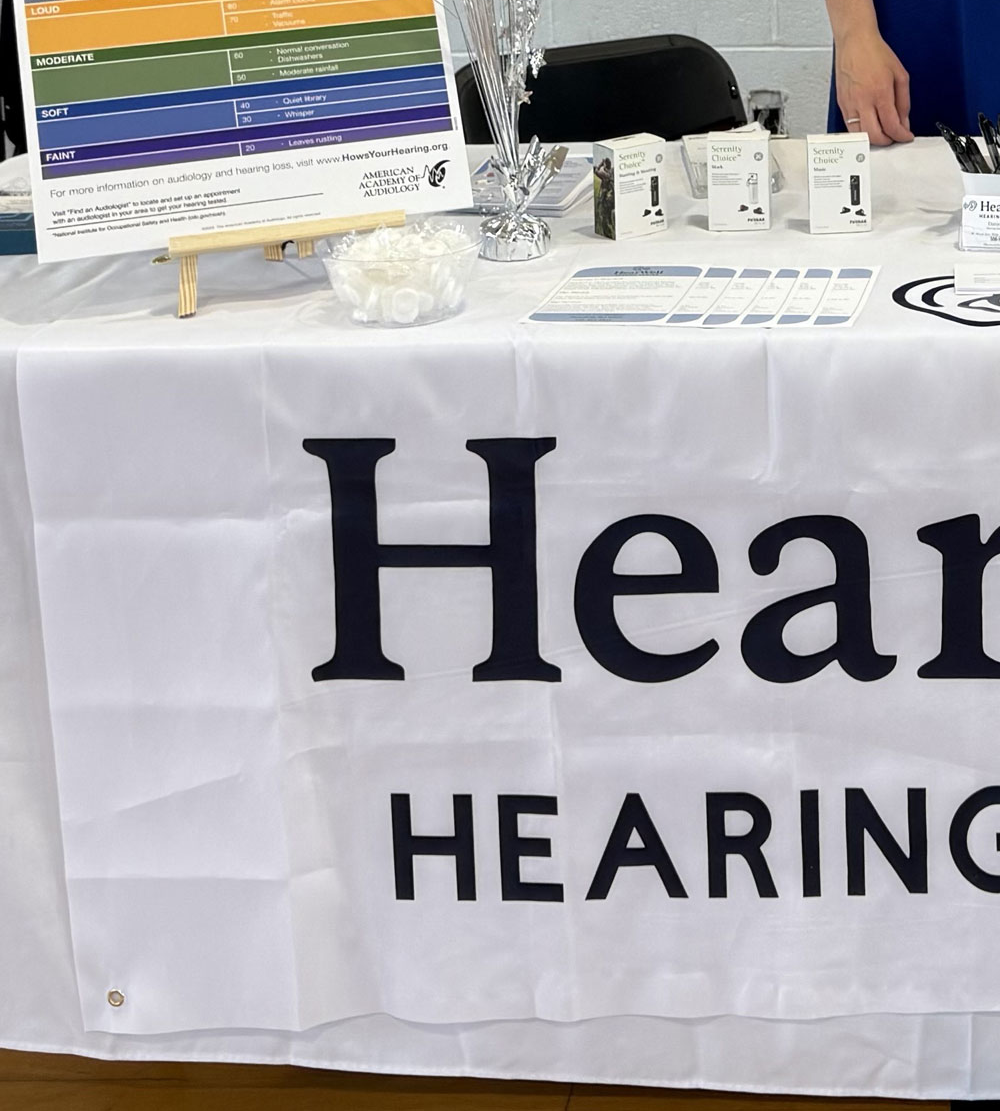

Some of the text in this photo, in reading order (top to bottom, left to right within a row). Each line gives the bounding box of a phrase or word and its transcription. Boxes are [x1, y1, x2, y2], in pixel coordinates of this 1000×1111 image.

[31, 6, 60, 16] LOUD
[276, 41, 350, 54] Normal conversation
[36, 53, 94, 66] MODERATE
[277, 53, 323, 63] Dishwashers
[280, 64, 338, 77] Moderate rainfall
[283, 94, 327, 105] Quiet library
[41, 108, 69, 118] SOFT
[285, 109, 315, 119] Whisper
[289, 134, 342, 146] Leaves rustling
[712, 145, 741, 153] Serenity
[46, 151, 76, 162] FAINT
[619, 151, 645, 161] Serenity
[50, 188, 66, 198] For
[69, 186, 94, 195] more
[97, 179, 149, 191] information
[168, 171, 212, 184] audiology
[215, 168, 233, 177] and
[236, 165, 270, 176] hearing
[273, 161, 294, 171] loss,
[296, 159, 314, 167] visit
[316, 143, 448, 165] www.HowsYourHearing.org
[363, 166, 414, 180] AMERICAN
[359, 175, 421, 189] ACADEMY OF
[364, 184, 420, 197] AUDIOLOGY
